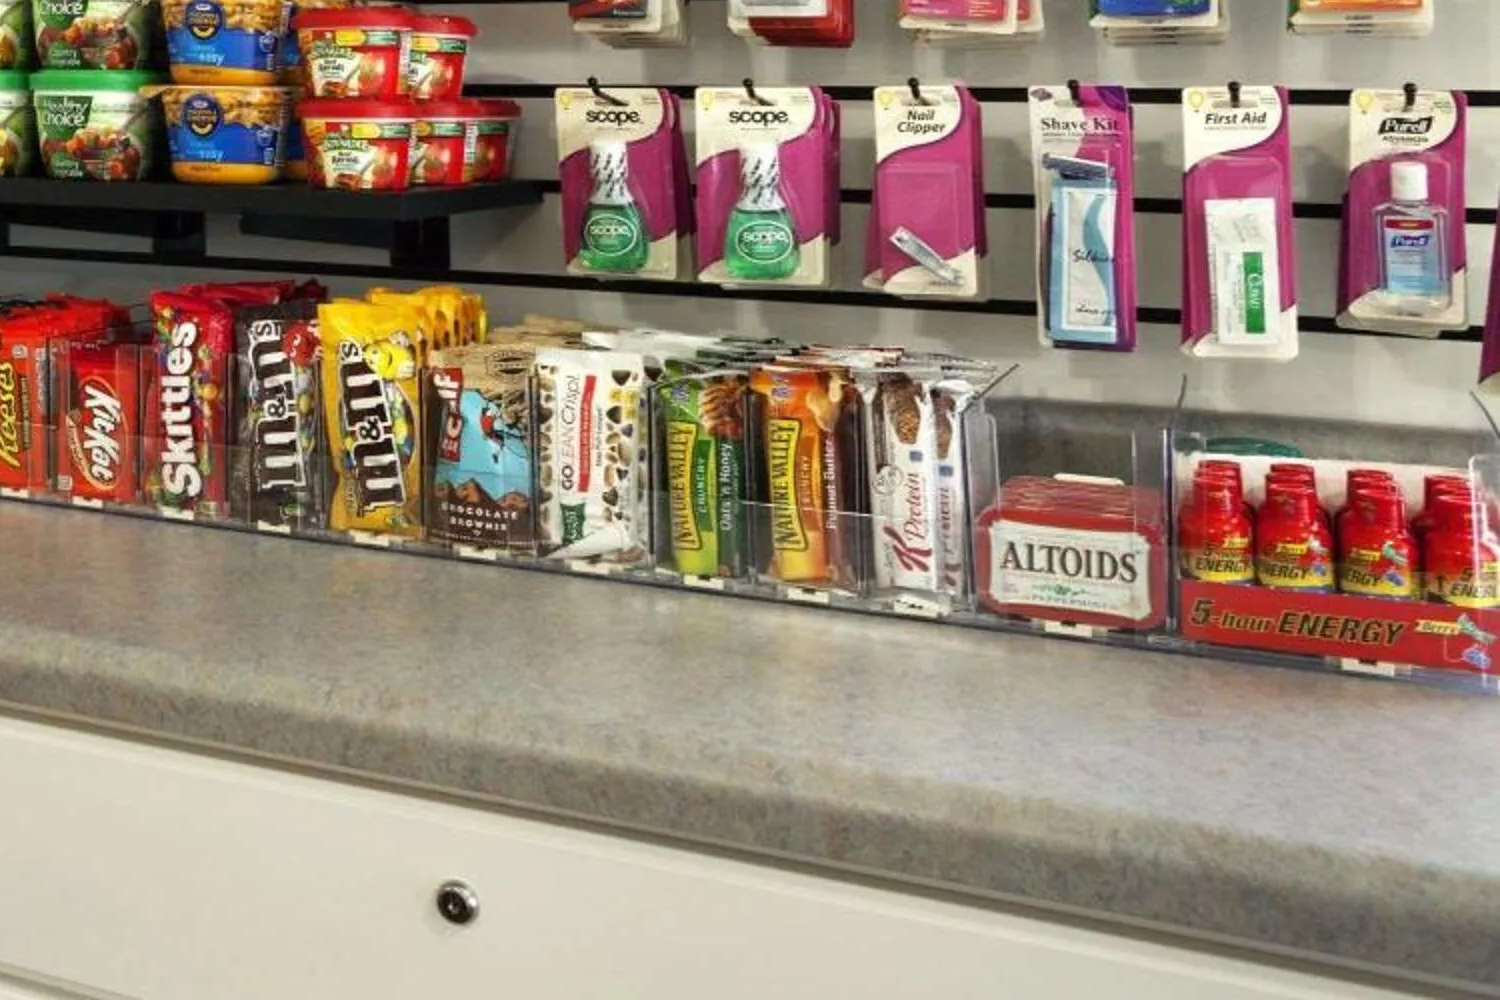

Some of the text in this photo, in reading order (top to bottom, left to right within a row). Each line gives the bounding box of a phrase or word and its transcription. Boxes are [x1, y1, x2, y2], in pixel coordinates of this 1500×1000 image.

[586, 110, 641, 127] scope
[729, 110, 789, 128] scope
[896, 121, 947, 135] Clipper
[906, 110, 935, 122] Nail
[1040, 116, 1119, 131] Shave Kit
[1204, 111, 1268, 125] First Aid
[589, 223, 630, 238] scope
[742, 229, 789, 246] scope
[160, 320, 203, 498] Skittles
[560, 374, 581, 425] Crisp!
[719, 442, 734, 484] Honey
[669, 425, 697, 545] NATURE VALLEY
[770, 423, 799, 545] NATURE VALLEY
[823, 438, 838, 530] Peanut Butter
[719, 500, 732, 531] Oats
[903, 472, 925, 541] Protein
[998, 540, 1139, 584] ALTOIDS
[1190, 598, 1272, 633] 5-hour
[1277, 610, 1406, 646] ENERGY
